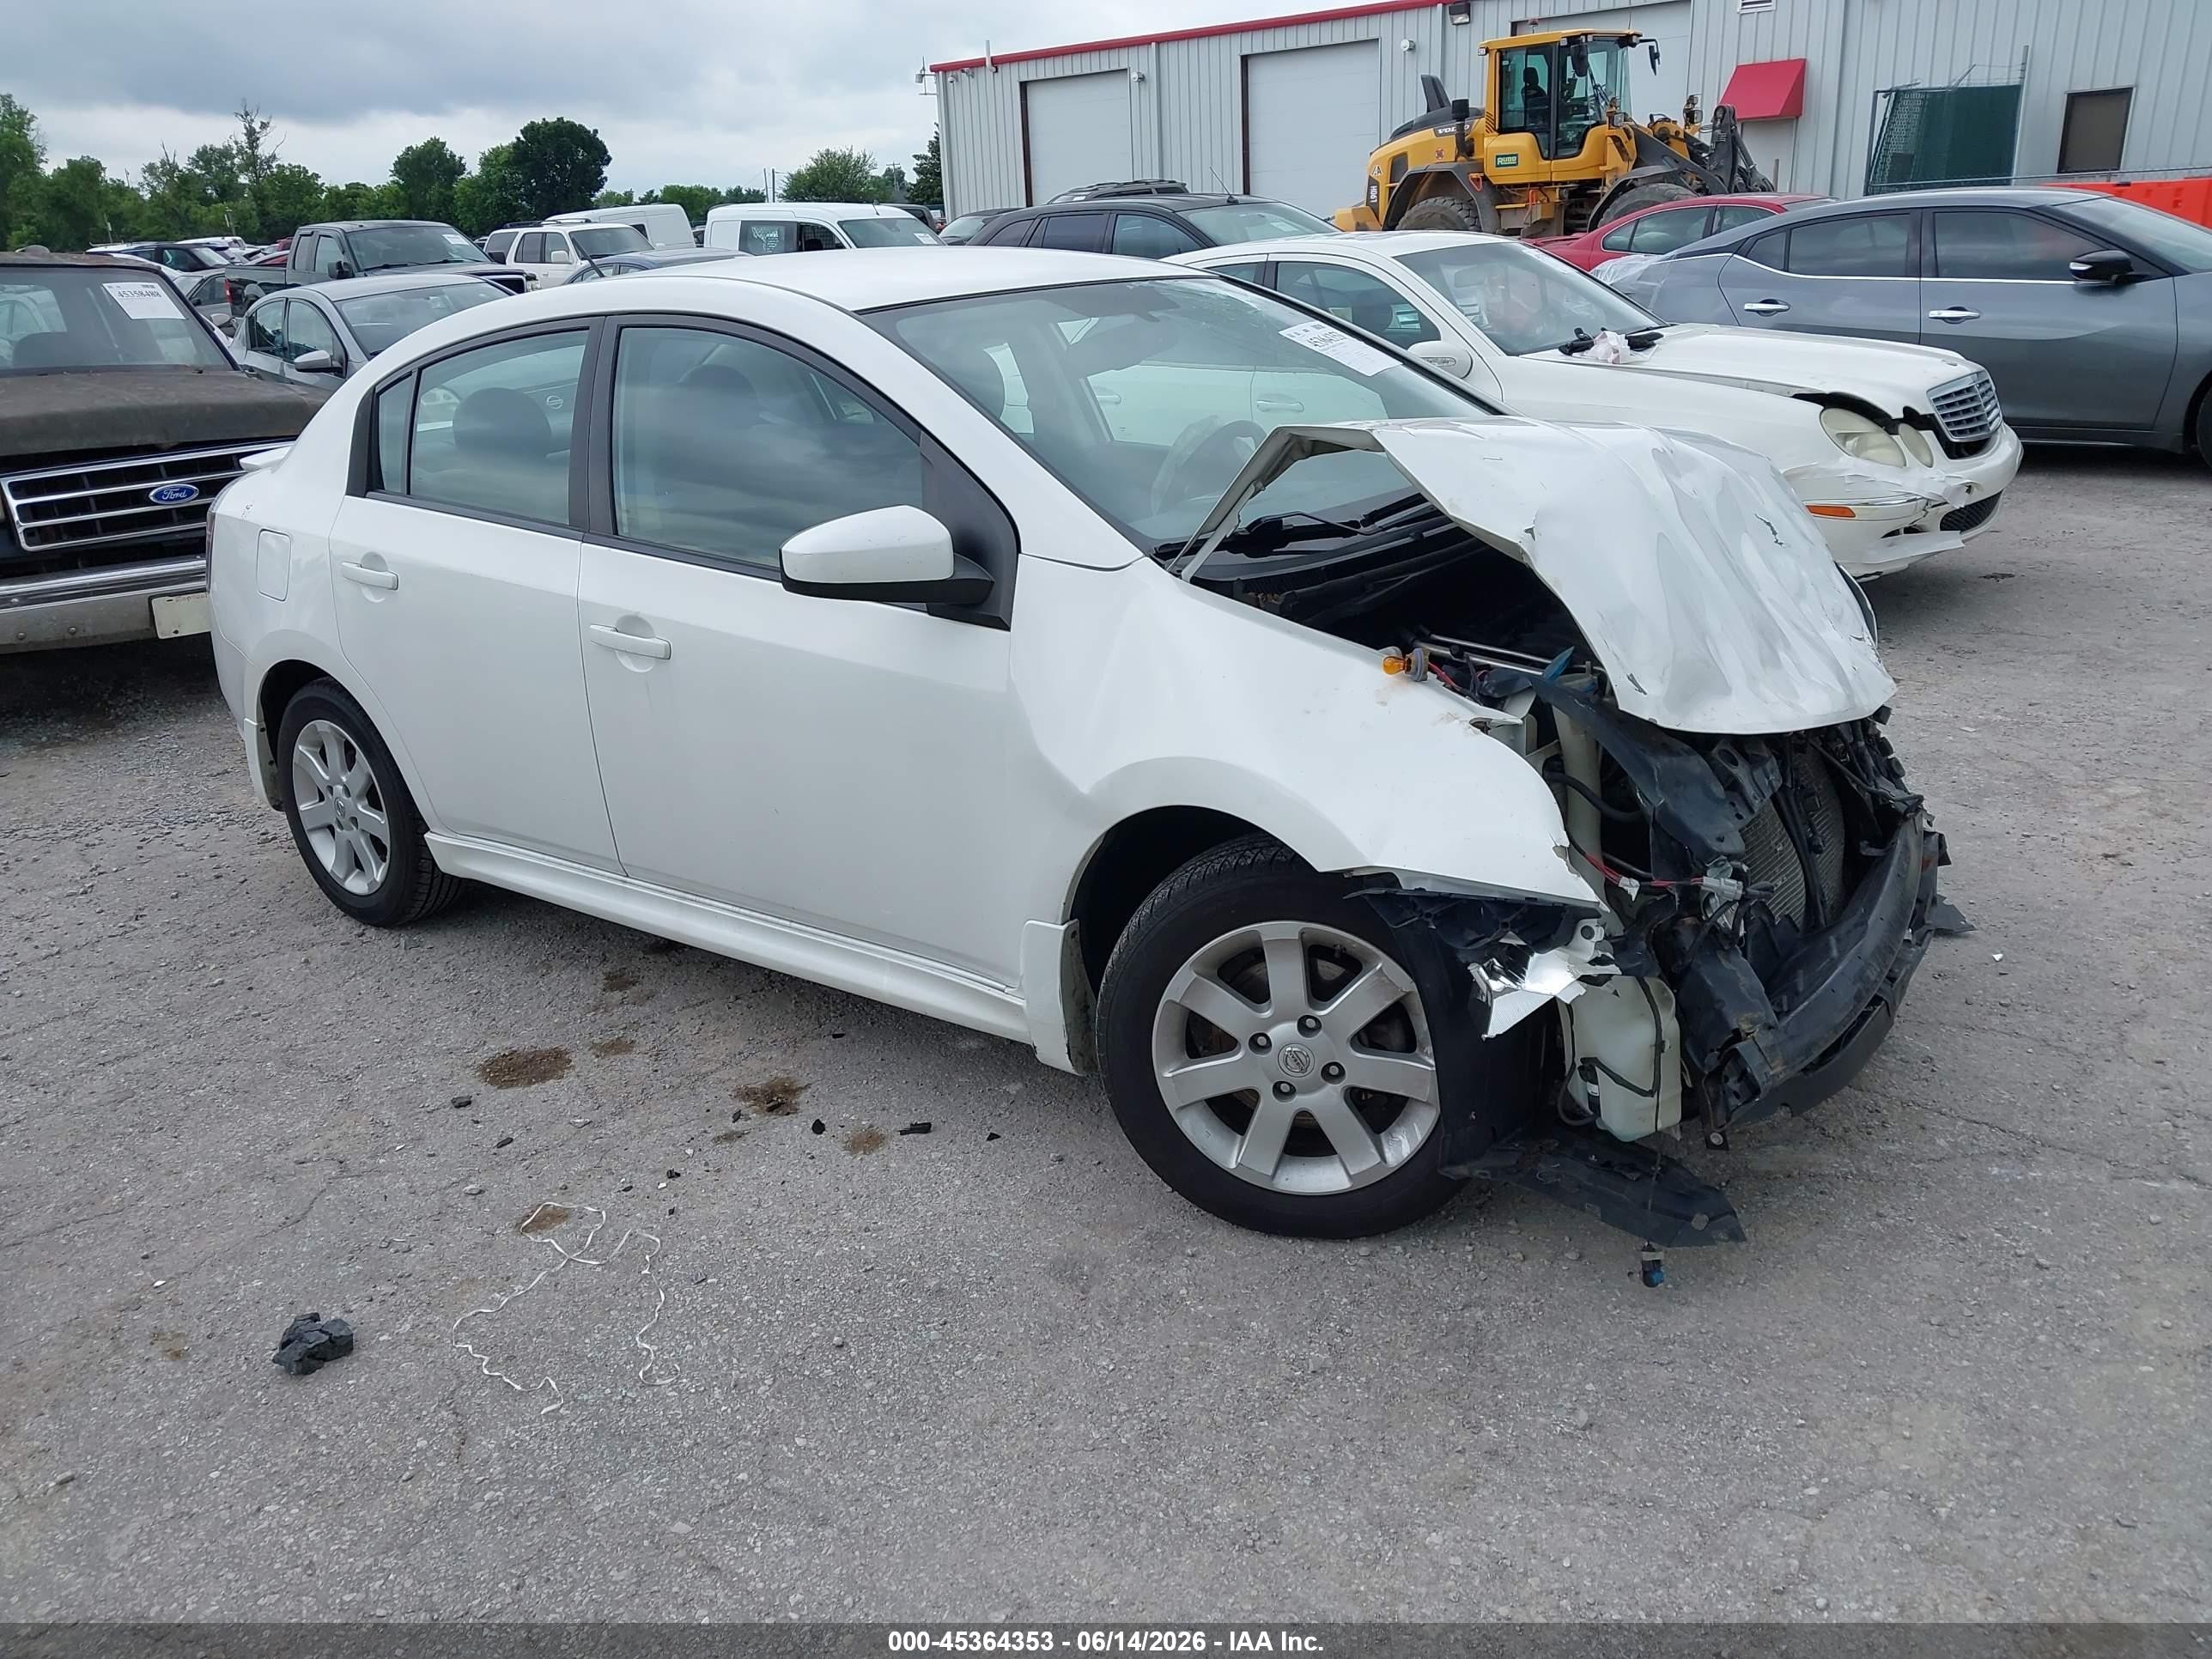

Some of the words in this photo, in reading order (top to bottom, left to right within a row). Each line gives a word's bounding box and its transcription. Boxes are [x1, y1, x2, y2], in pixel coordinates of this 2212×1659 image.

[1437, 124, 1470, 134] VOLO
[1370, 185, 1378, 204] L90H
[162, 488, 187, 500] Ford
